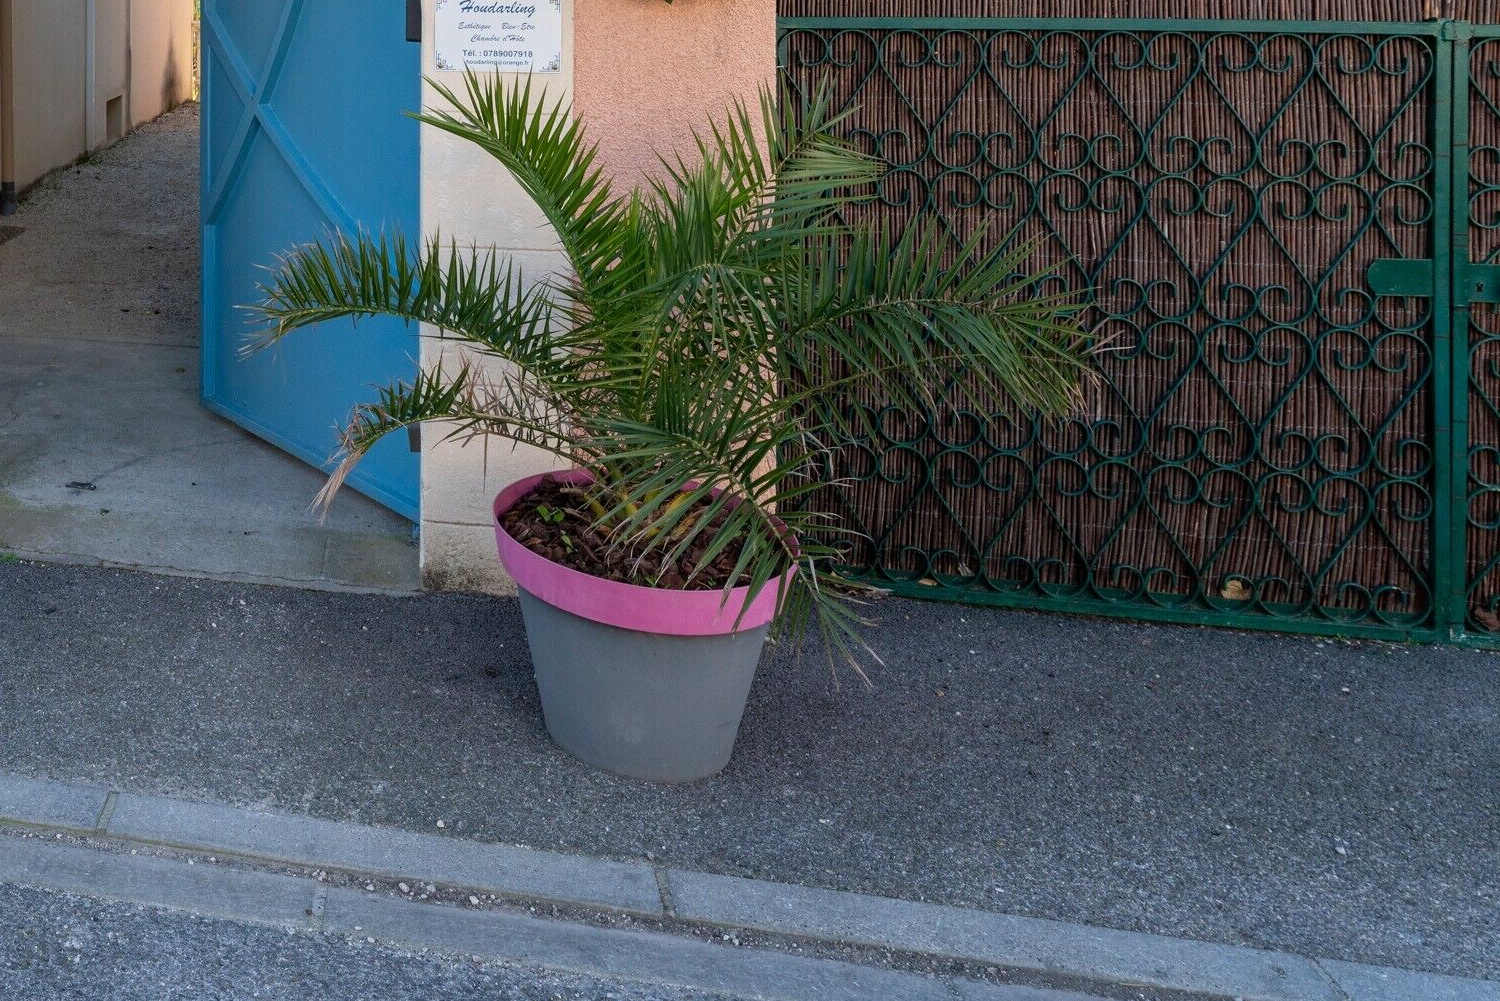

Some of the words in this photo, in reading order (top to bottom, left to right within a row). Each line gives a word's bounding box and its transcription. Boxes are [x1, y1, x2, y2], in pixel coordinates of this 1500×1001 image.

[459, 0, 536, 18] Houdarling
[458, 21, 492, 31] Esthétique
[470, 33, 500, 43] Chambre
[502, 34, 526, 42] d'Hôte
